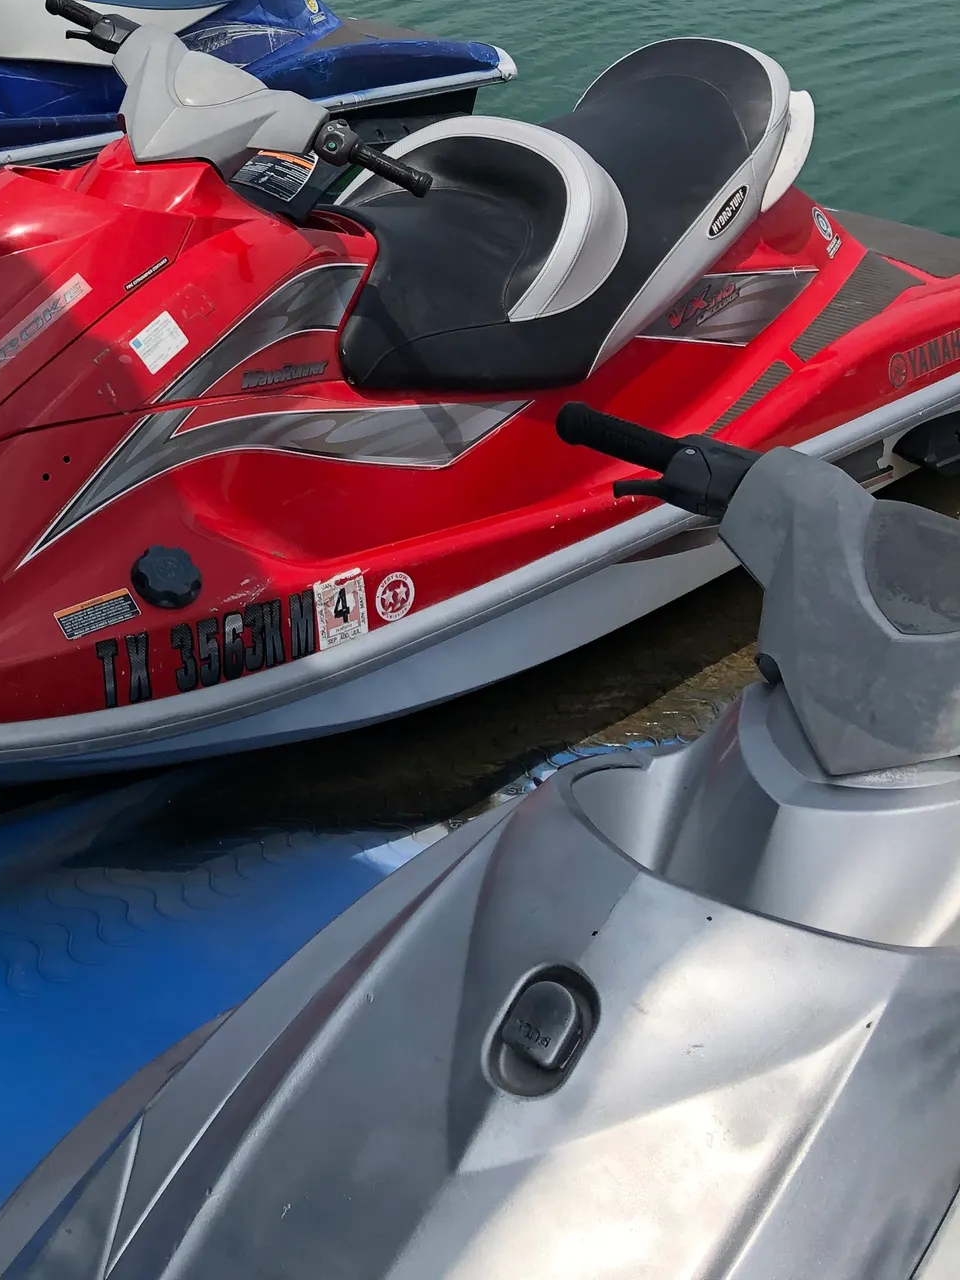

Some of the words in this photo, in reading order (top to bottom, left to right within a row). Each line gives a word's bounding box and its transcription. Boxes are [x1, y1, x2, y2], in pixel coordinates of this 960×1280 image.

[711, 189, 744, 234] HYDRO-TURF
[242, 361, 328, 390] WaveRunner
[906, 328, 960, 380] YAMAH
[334, 587, 351, 623] 4
[95, 631, 153, 709] TX
